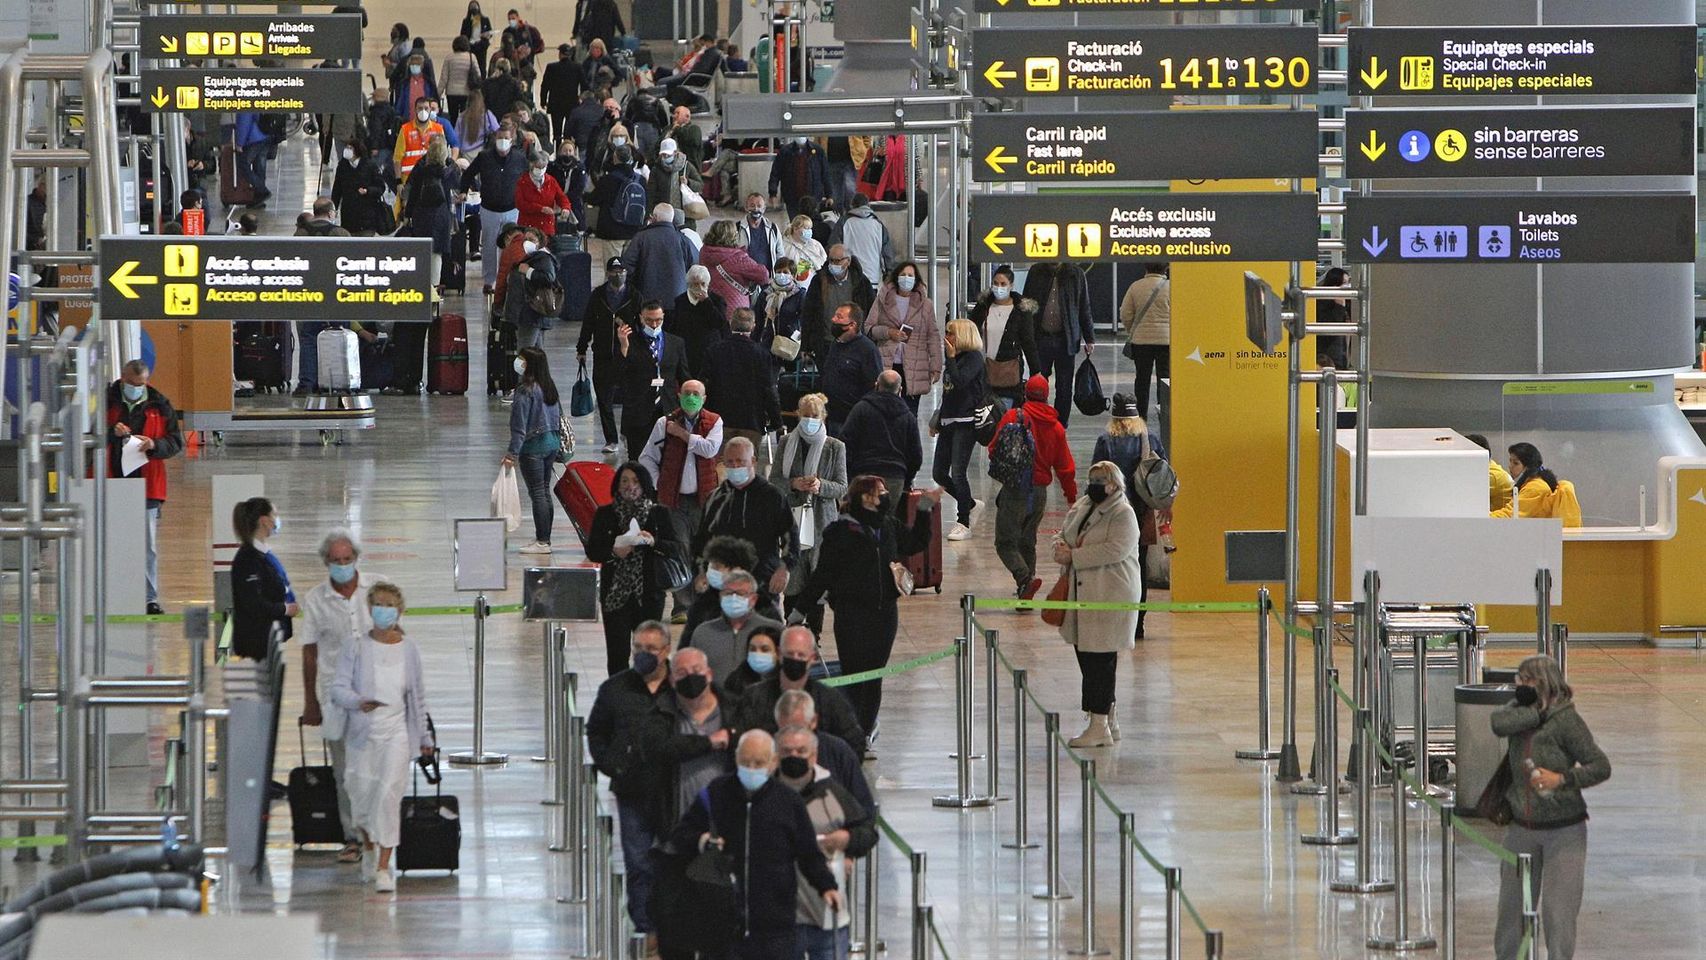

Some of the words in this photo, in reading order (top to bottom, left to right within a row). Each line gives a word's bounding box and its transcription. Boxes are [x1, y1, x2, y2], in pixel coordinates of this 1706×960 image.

[268, 22, 314, 32] Arribades
[269, 44, 311, 56] Llegadas
[1068, 41, 1142, 56] Facturació
[1443, 40, 1523, 57] Equipatges
[1528, 40, 1594, 56] especials
[1068, 59, 1122, 72] Check-in
[1443, 57, 1487, 73] Special
[1492, 58, 1546, 70] Check-in
[1160, 58, 1223, 88] 141
[1225, 57, 1238, 70] to
[1244, 57, 1309, 88] 130
[204, 76, 257, 88] Equipatges
[260, 77, 304, 88] especials
[1068, 74, 1151, 89] Facturación
[1228, 77, 1236, 87] a
[1443, 74, 1513, 91] Equipajes
[1518, 73, 1592, 90] especiales
[205, 87, 234, 97] Special
[236, 87, 270, 97] check-in
[204, 98, 251, 109] Equipajes
[254, 98, 303, 110] especiales
[1026, 127, 1065, 141] Carril
[1070, 126, 1106, 144] ràpid
[1474, 127, 1500, 143] sin
[1505, 127, 1578, 142] barreras
[1027, 145, 1053, 157] Fast
[1056, 144, 1082, 157] lane
[1475, 147, 1527, 159] sense
[1532, 143, 1604, 158] barreres
[1027, 160, 1065, 174] Carril
[1071, 160, 1115, 176] rápido
[1110, 207, 1153, 222] Accés
[1158, 208, 1215, 222] exclusiu
[1519, 211, 1577, 225] Lavabos
[1110, 225, 1166, 238] Exclusive
[1169, 227, 1211, 238] access
[1519, 229, 1559, 241] Toilets
[1111, 241, 1161, 255] Acceso
[1166, 241, 1231, 255] exclusivo
[1520, 246, 1560, 258] Aseos
[206, 256, 250, 270] Accés
[251, 257, 309, 270] exclusiu
[336, 257, 376, 271] Carril
[379, 256, 416, 274] ràpid
[60, 275, 94, 284] PROTEC
[205, 273, 261, 285] Exclusive
[262, 276, 303, 285] access
[336, 273, 362, 286] Fast
[364, 274, 390, 286] lane
[206, 289, 257, 301] Acceso
[260, 289, 323, 302] exclusivo
[337, 289, 375, 302] Carril
[379, 289, 423, 305] rápido
[64, 300, 94, 308] LUGGA
[1236, 350, 1249, 358] sin
[1251, 350, 1287, 358] barreras
[1235, 361, 1260, 369] barrier
[1262, 361, 1278, 369] free
